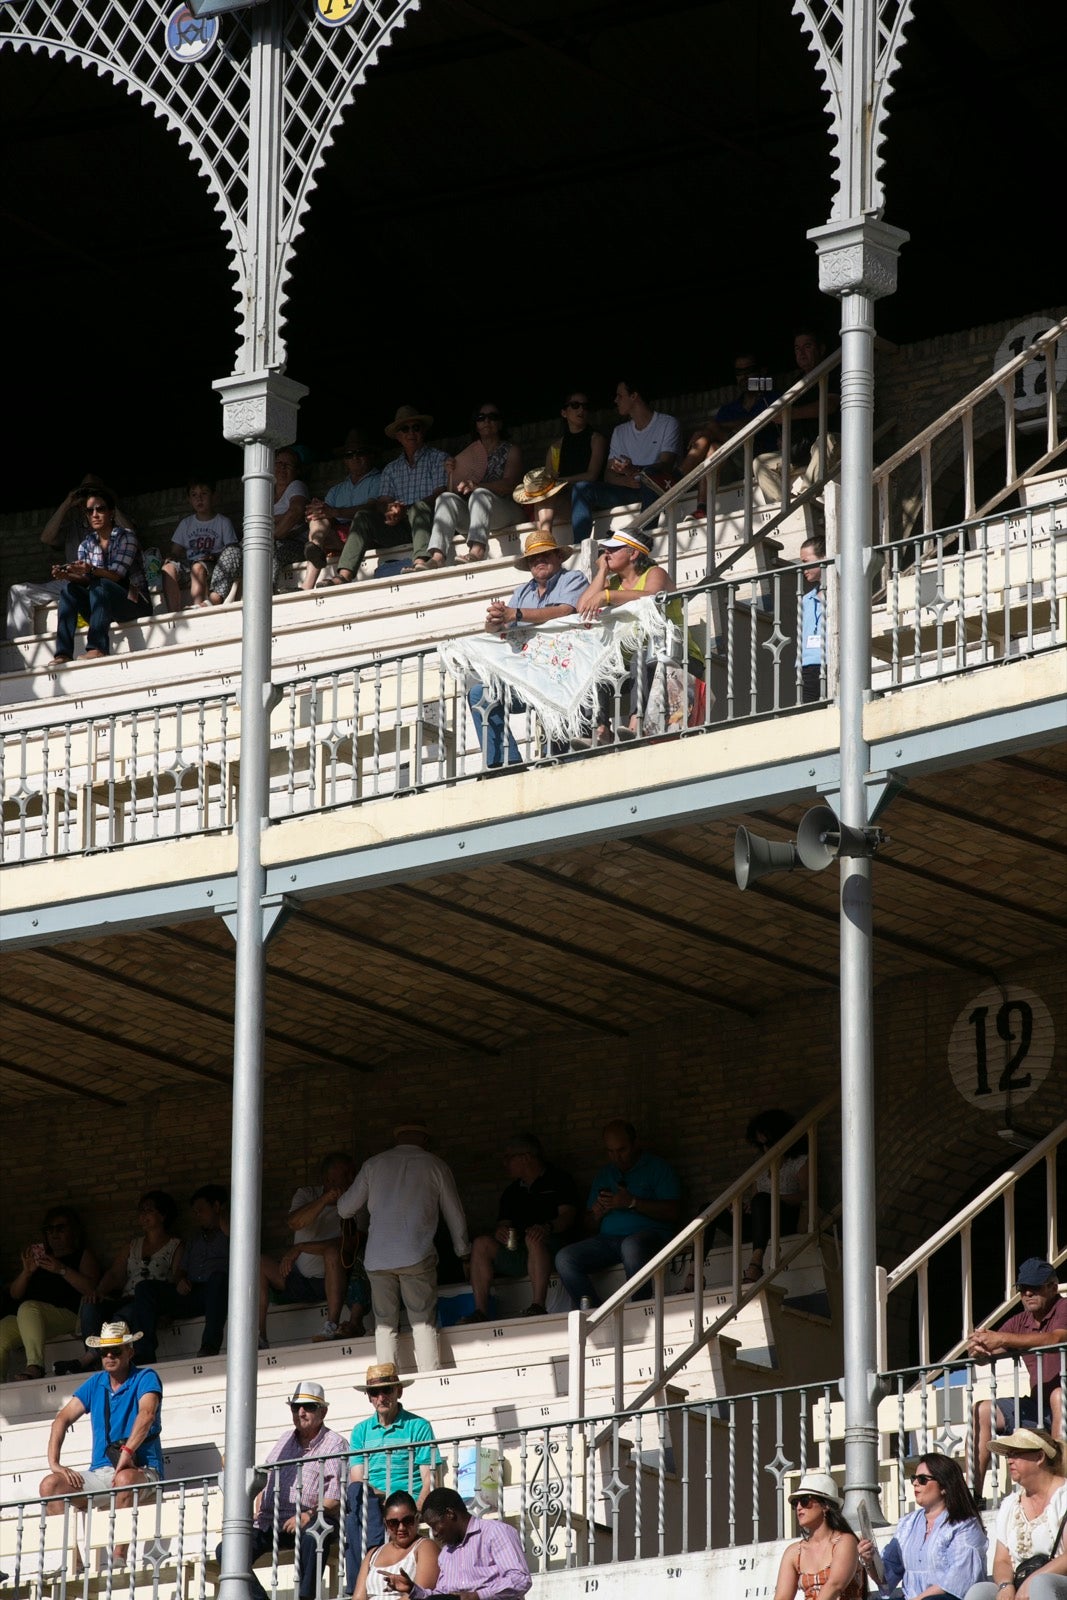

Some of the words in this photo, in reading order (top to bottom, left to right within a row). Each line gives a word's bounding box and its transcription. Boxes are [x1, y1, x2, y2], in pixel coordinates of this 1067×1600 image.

[761, 513, 771, 521] 19
[688, 528, 698, 538] 18
[197, 537, 216, 550] GO!
[168, 620, 176, 629] 11
[194, 647, 204, 657] 12
[120, 661, 129, 670] 11
[48, 673, 58, 681] 10
[147, 688, 157, 698] 12
[75, 701, 84, 710] 11
[3, 712, 13, 722] 10
[97, 729, 107, 737] 12
[54, 769, 64, 778] 12
[969, 1000, 1034, 1096] 12
[716, 1296, 727, 1305] 19
[172, 1327, 181, 1336] 11
[493, 1328, 504, 1337] 16
[342, 1346, 352, 1355] 14
[664, 1347, 674, 1356] 19
[192, 1365, 203, 1374] 12
[516, 1368, 527, 1377] 17
[440, 1378, 450, 1386] 16
[47, 1384, 57, 1393] 10
[467, 1418, 476, 1427] 17
[13, 1474, 22, 1484] 11
[738, 1557, 755, 1571] 21
[666, 1567, 682, 1578] 20
[584, 1579, 599, 1593] 19
[745, 1586, 777, 1599] FIL
